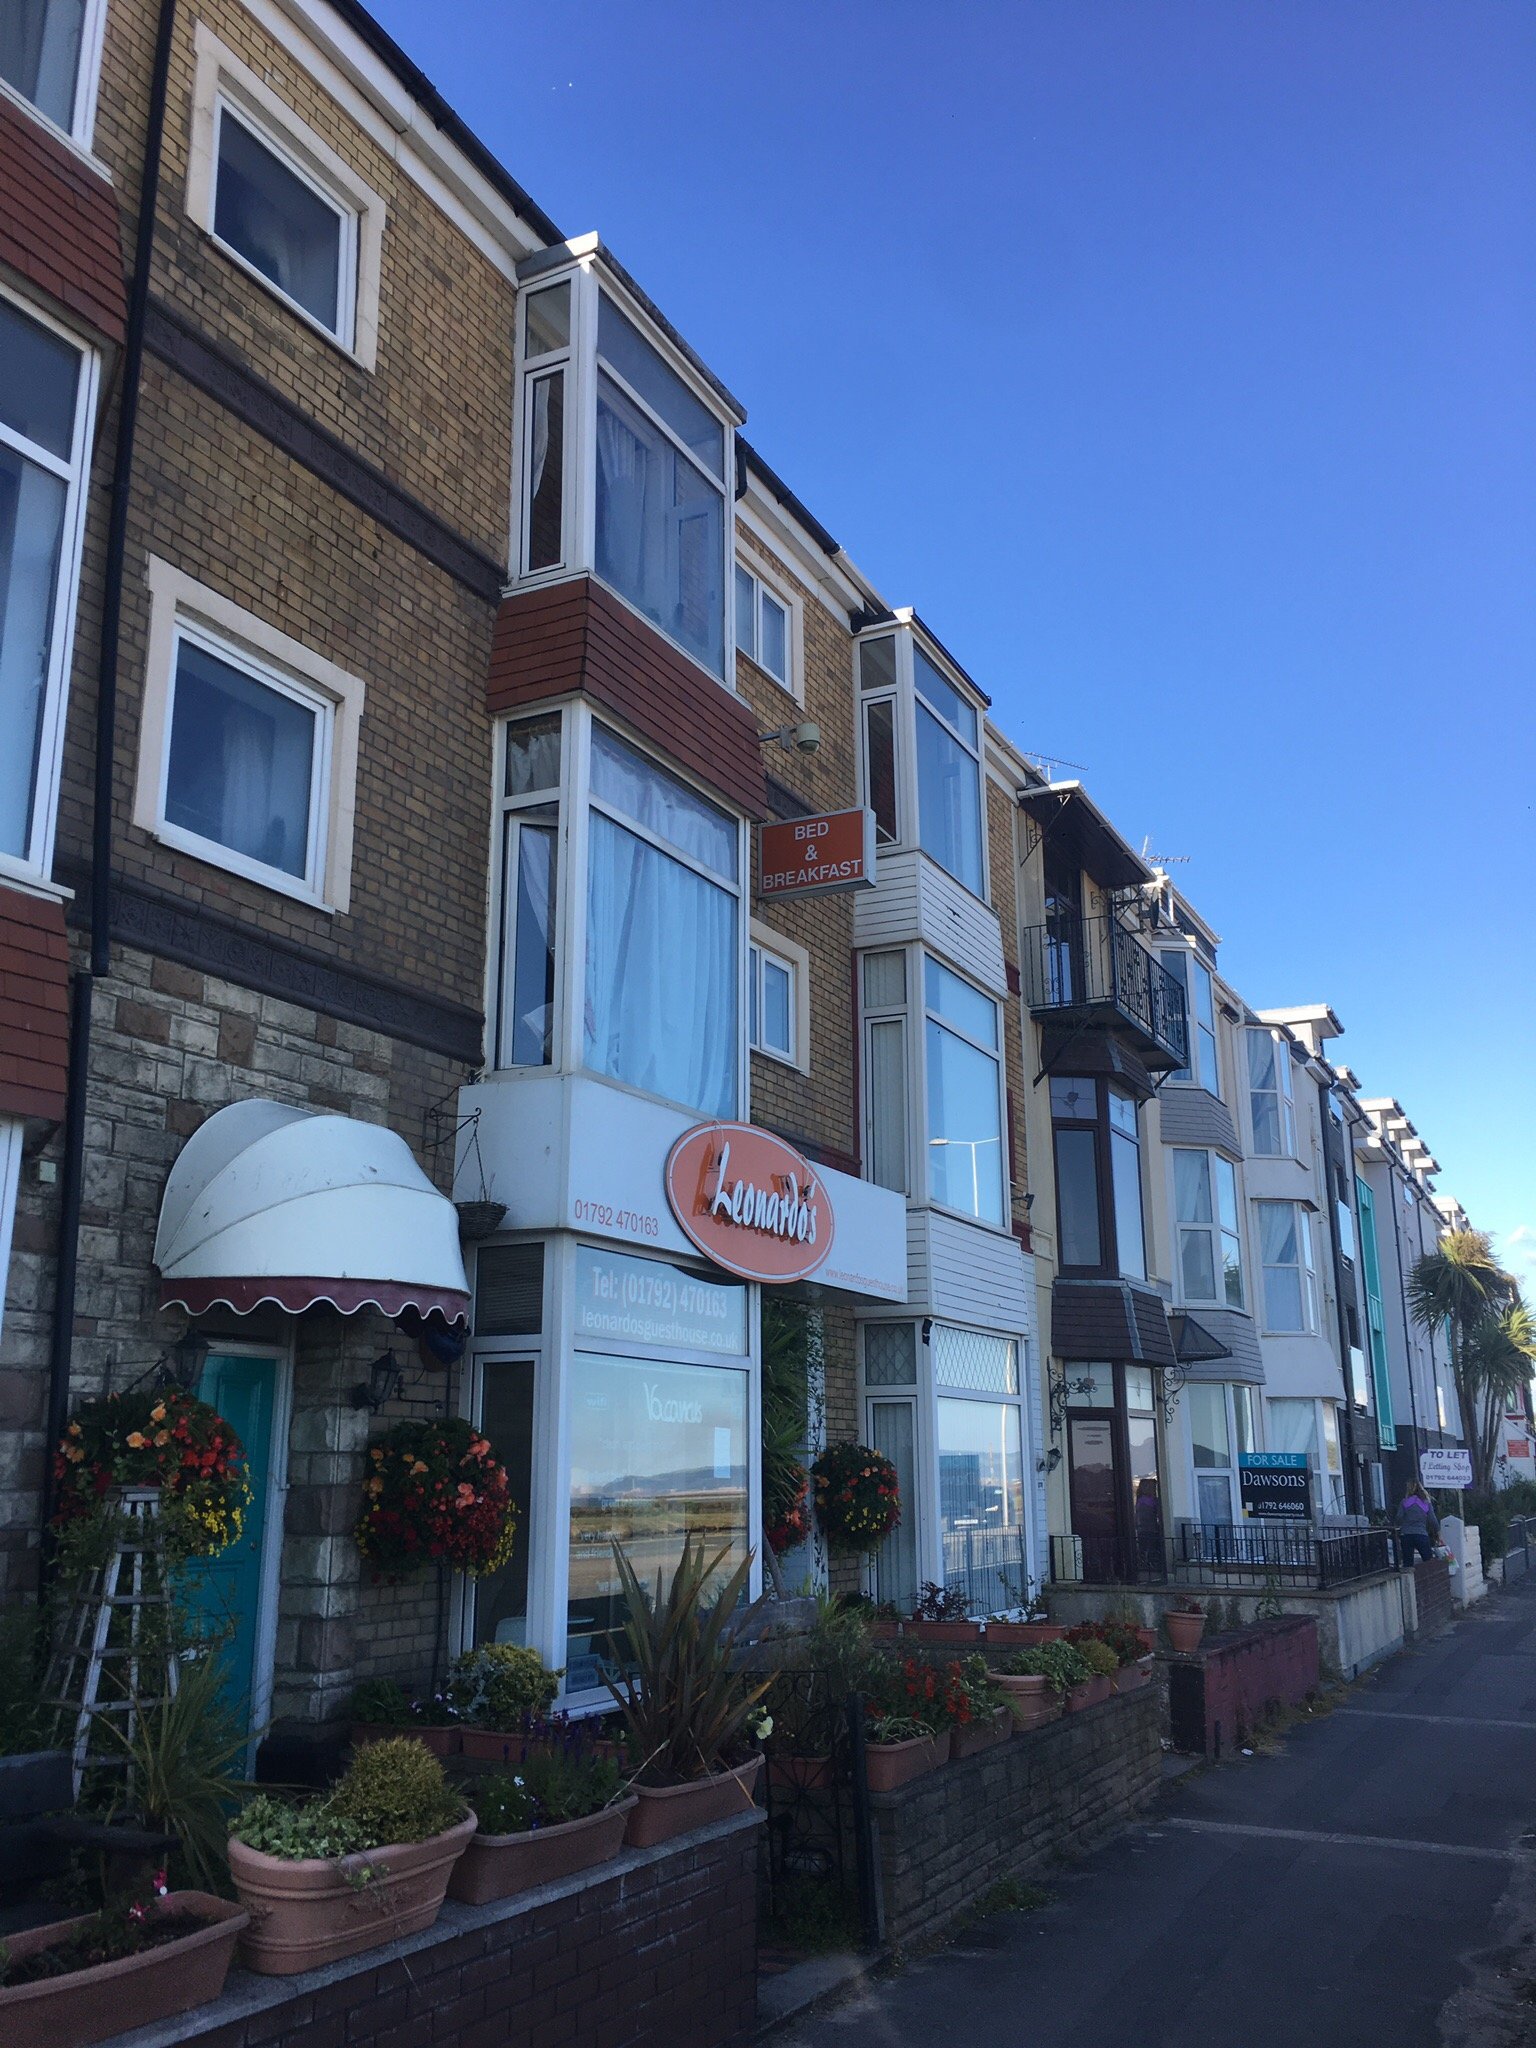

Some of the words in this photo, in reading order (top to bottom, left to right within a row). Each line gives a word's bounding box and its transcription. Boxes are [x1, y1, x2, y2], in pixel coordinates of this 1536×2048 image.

[794, 821, 829, 840] BED
[804, 844, 818, 861] &
[762, 859, 862, 889] BREAKFAST
[710, 1141, 818, 1245] Leonardo's
[574, 1199, 613, 1227] 01792
[616, 1210, 659, 1237] 470163
[592, 1266, 618, 1299] Tel:
[622, 1271, 677, 1316] (01792)
[680, 1285, 728, 1319] 470163
[582, 1305, 739, 1350] leonardosguesthouse.co.uk
[1247, 1455, 1269, 1466] FOR
[1271, 1455, 1297, 1466] SALE
[1430, 1451, 1444, 1459] TO
[1447, 1451, 1468, 1459] LET
[1453, 1462, 1470, 1473] Shop
[1242, 1470, 1306, 1487] Dawsons
[1258, 1501, 1277, 1510] 01792
[1278, 1502, 1304, 1511] 646060
